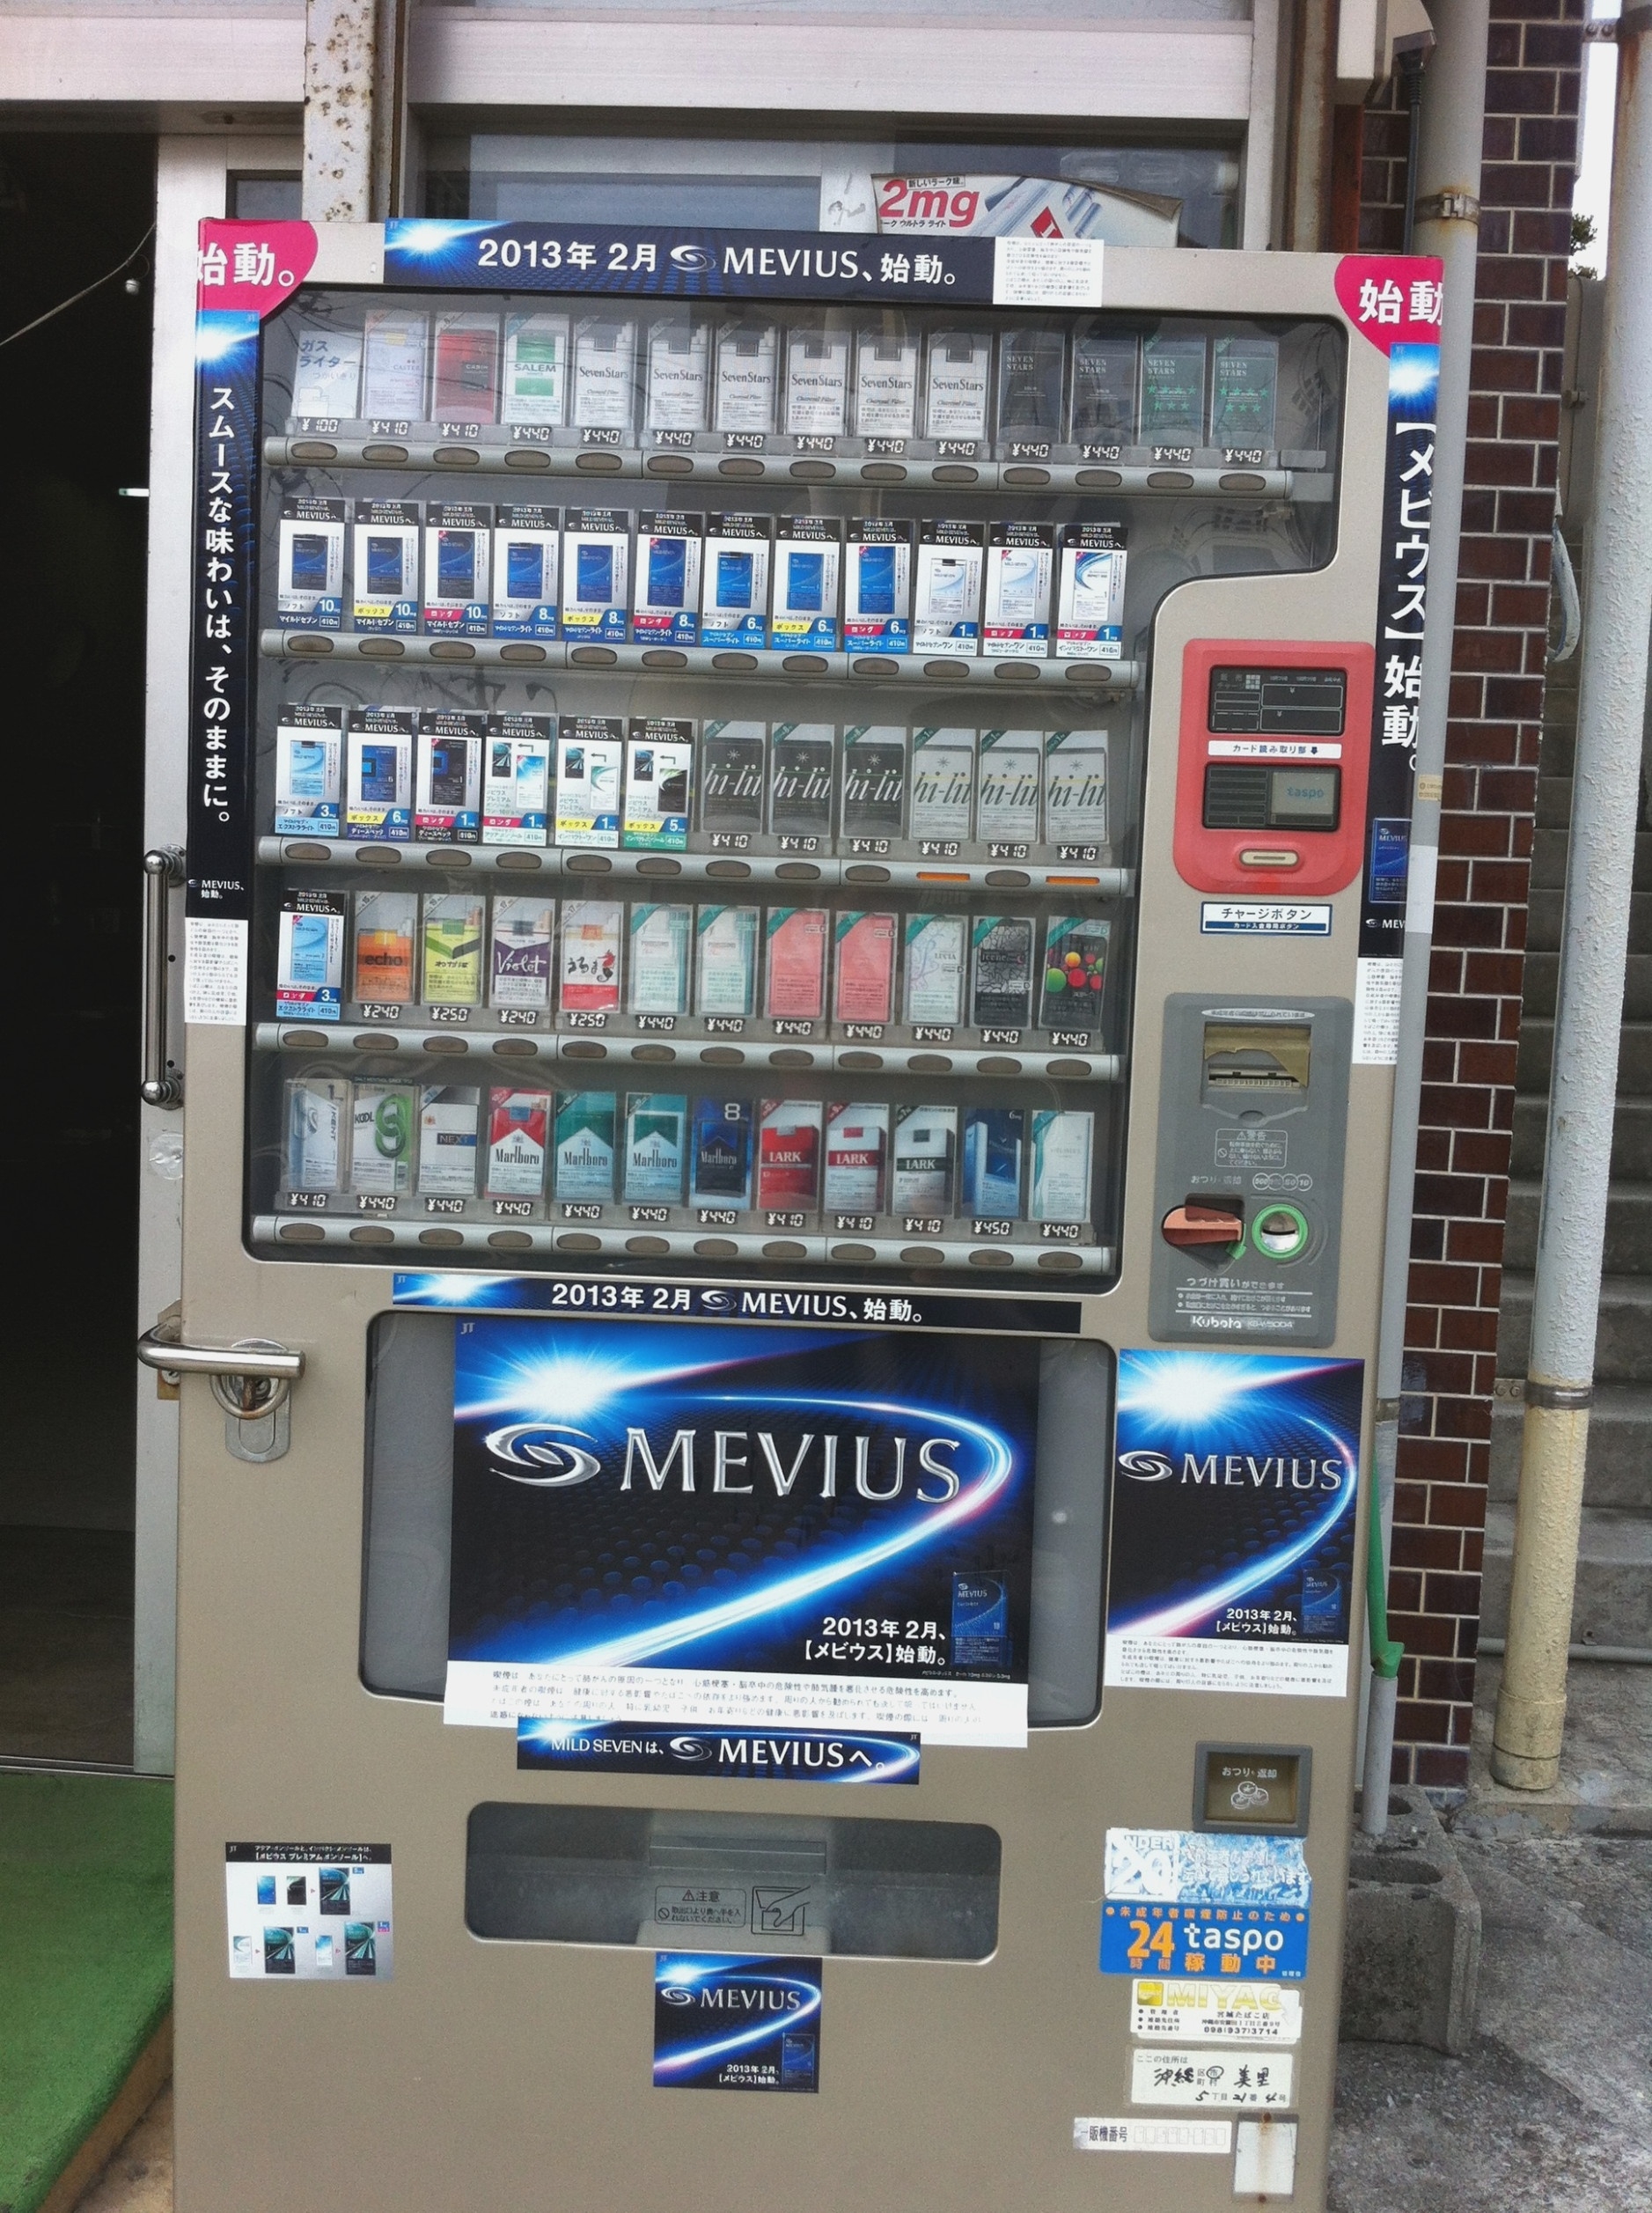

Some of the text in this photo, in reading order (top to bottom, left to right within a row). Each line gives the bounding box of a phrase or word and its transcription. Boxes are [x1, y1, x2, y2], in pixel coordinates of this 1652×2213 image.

[880, 179, 979, 228] 2mg
[478, 239, 597, 270] 2013年
[607, 243, 657, 273] 2月
[196, 242, 295, 288] 始動。
[301, 340, 328, 352] ガス
[300, 356, 356, 368] ライター
[514, 364, 556, 373] SALEM
[371, 421, 408, 436] ¥410
[442, 423, 479, 438] ¥410
[513, 426, 549, 441] ¥440
[584, 429, 620, 444] ¥440
[656, 431, 692, 446] ¥440
[727, 434, 763, 449] ¥440
[797, 437, 833, 452] ¥440
[868, 439, 904, 454] ¥440
[938, 442, 974, 457] ¥440
[1012, 444, 1048, 458] ¥440
[1083, 445, 1120, 460] ¥440
[1155, 447, 1191, 462] ¥440
[1226, 448, 1262, 464] ¥440
[203, 386, 236, 824] スムースな味わいは、そのままに。
[1233, 745, 1307, 755] カード読み取り部
[1287, 786, 1325, 799] taspo
[713, 834, 748, 849] ¥410
[782, 836, 817, 850] ¥410
[853, 839, 888, 853] ¥410
[922, 842, 958, 856] ¥410
[991, 843, 1027, 858] ¥410
[1061, 845, 1096, 860] ¥410
[1222, 908, 1311, 921] チャージボタン
[364, 952, 403, 967] echo
[497, 950, 547, 974] Violet
[363, 1004, 399, 1019] ¥240
[431, 1007, 467, 1022] ¥250
[501, 1010, 536, 1025] ¥240
[570, 1012, 606, 1027] ¥250
[639, 1015, 674, 1030] ¥440
[708, 1018, 743, 1033] ¥440
[775, 1021, 811, 1036] ¥440
[847, 1024, 882, 1039] ¥440
[915, 1027, 951, 1041] ¥440
[983, 1030, 1018, 1044] ¥440
[1052, 1032, 1088, 1047] ¥440
[354, 1112, 375, 1124] KOOL
[329, 1111, 338, 1143] KENT
[439, 1134, 469, 1145] NEXT
[495, 1145, 540, 1165] Marlboro
[564, 1148, 608, 1167] Marlboro
[633, 1150, 678, 1169] Marlboro
[701, 1149, 738, 1169] Marlboro
[769, 1151, 802, 1163] LARK
[836, 1152, 869, 1165] LARK
[906, 1158, 936, 1170] LARK
[290, 1193, 327, 1208] ¥410
[359, 1195, 394, 1210] ¥440
[428, 1198, 463, 1213] ¥440
[496, 1201, 531, 1216] ¥440
[565, 1204, 600, 1219] ¥440
[632, 1207, 667, 1222] ¥440
[701, 1209, 736, 1224] ¥440
[767, 1212, 804, 1227] ¥410
[837, 1216, 871, 1231] ¥410
[906, 1218, 941, 1232] ¥410
[975, 1220, 1010, 1235] ¥450
[1043, 1224, 1078, 1239] ¥440
[551, 1283, 644, 1309] 2013年
[653, 1287, 692, 1311] 2月
[460, 1321, 476, 1335] JT
[1193, 1315, 1243, 1328] Kubota
[620, 1427, 961, 1504] MEVIUS
[1180, 1452, 1343, 1490] MEVIUS
[957, 1589, 988, 1599] MEVIUS
[1226, 1607, 1298, 1622] 2013年 2月、
[822, 1616, 947, 1640] 2013年 2月、
[1215, 1621, 1297, 1637] 【メビウス】始動。
[804, 1639, 947, 1665] 【メビウス】始動。
[551, 1737, 591, 1752] MILD
[1222, 1767, 1278, 1779] おつり・返却
[695, 1890, 721, 1903] 注意
[1127, 1920, 1284, 1959] 24 taspo
[1129, 1956, 1171, 1971] 時間
[701, 1988, 801, 2011] MEVIUS
[1203, 2026, 1279, 2036] 098(937)3714
[1136, 2055, 1189, 2064] ここの住所は
[726, 2063, 760, 2073] 2013年
